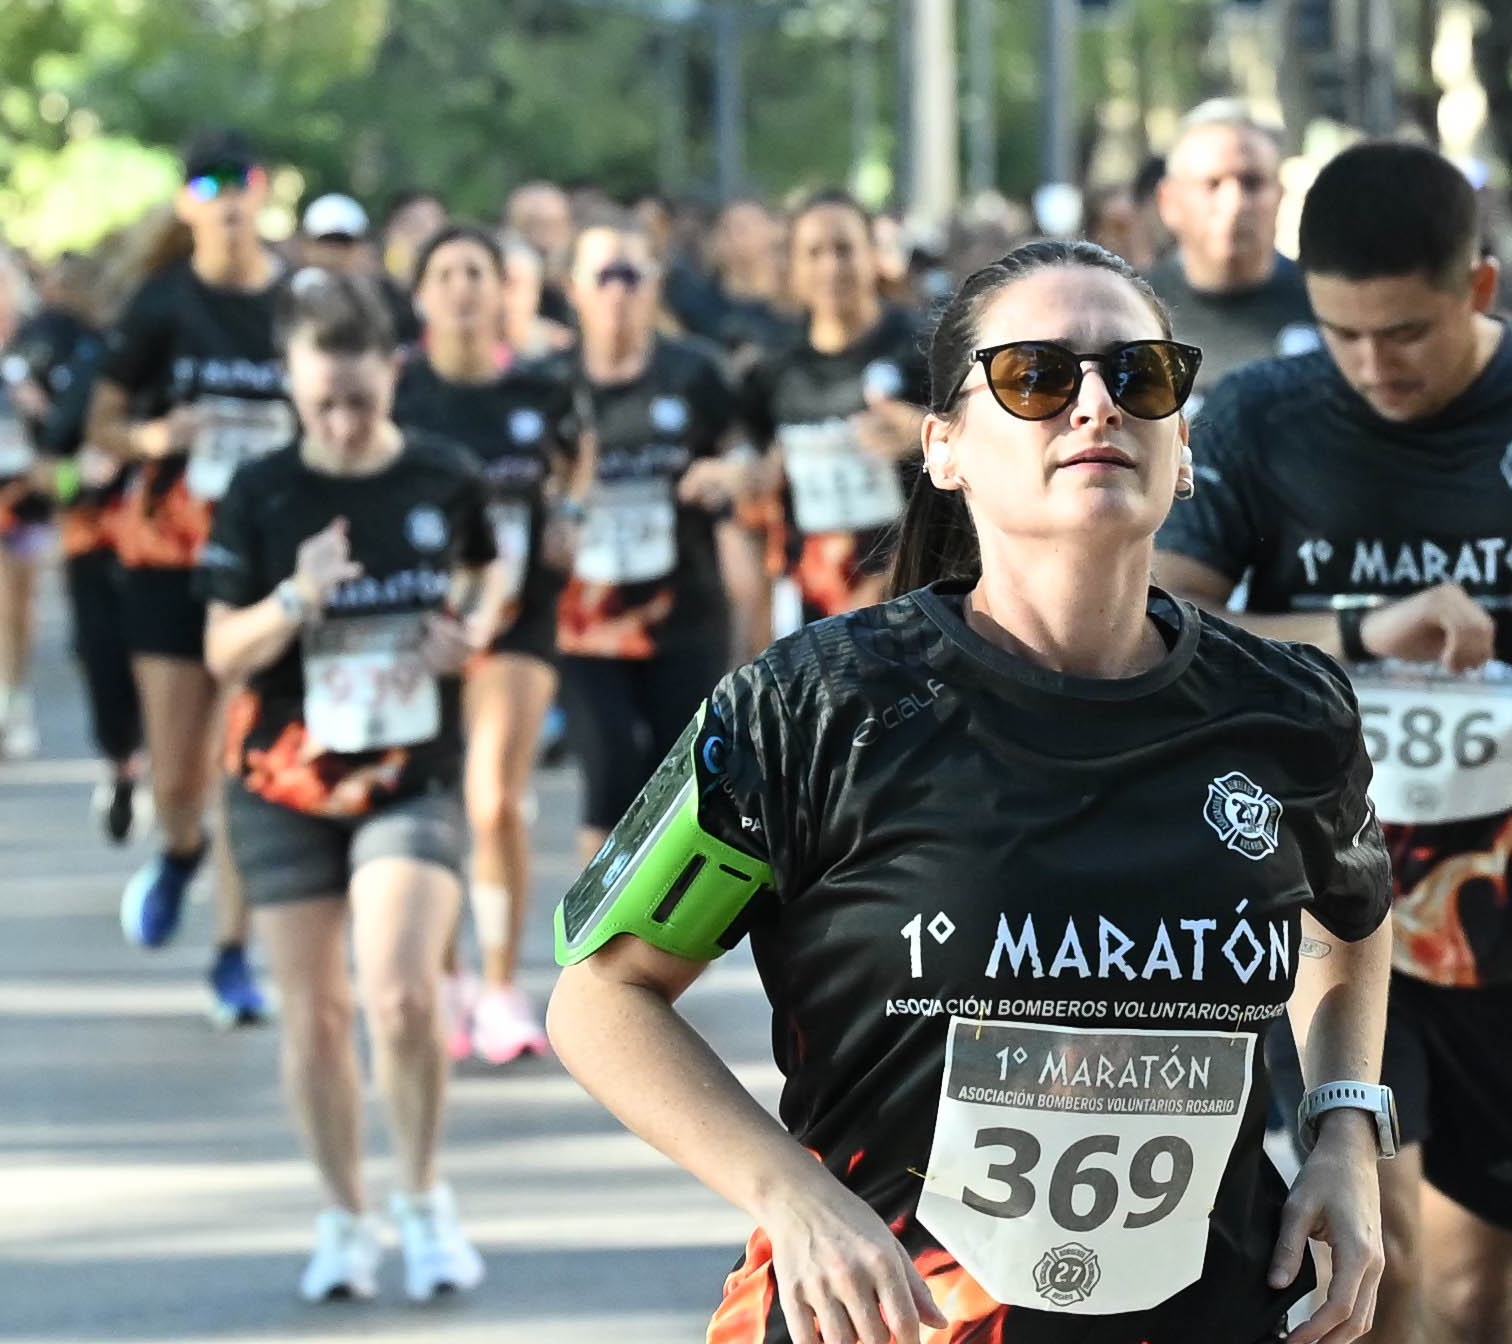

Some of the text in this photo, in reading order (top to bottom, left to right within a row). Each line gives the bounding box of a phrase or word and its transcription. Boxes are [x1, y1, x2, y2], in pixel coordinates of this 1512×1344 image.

[984, 898, 1289, 984] MARATÓN
[886, 994, 993, 1017] ASOCIACIÓN
[997, 999, 1107, 1018] BOMBEROS
[1113, 1001, 1241, 1022] VOLUNTARIOS
[1038, 1044, 1211, 1090] MARATÓN
[958, 1085, 1235, 1113] ASOCIACIÓN BOMBEROS VOLUNTARIOS ROSARIO
[962, 1127, 1194, 1232] 369
[1055, 1262, 1083, 1283] 27
